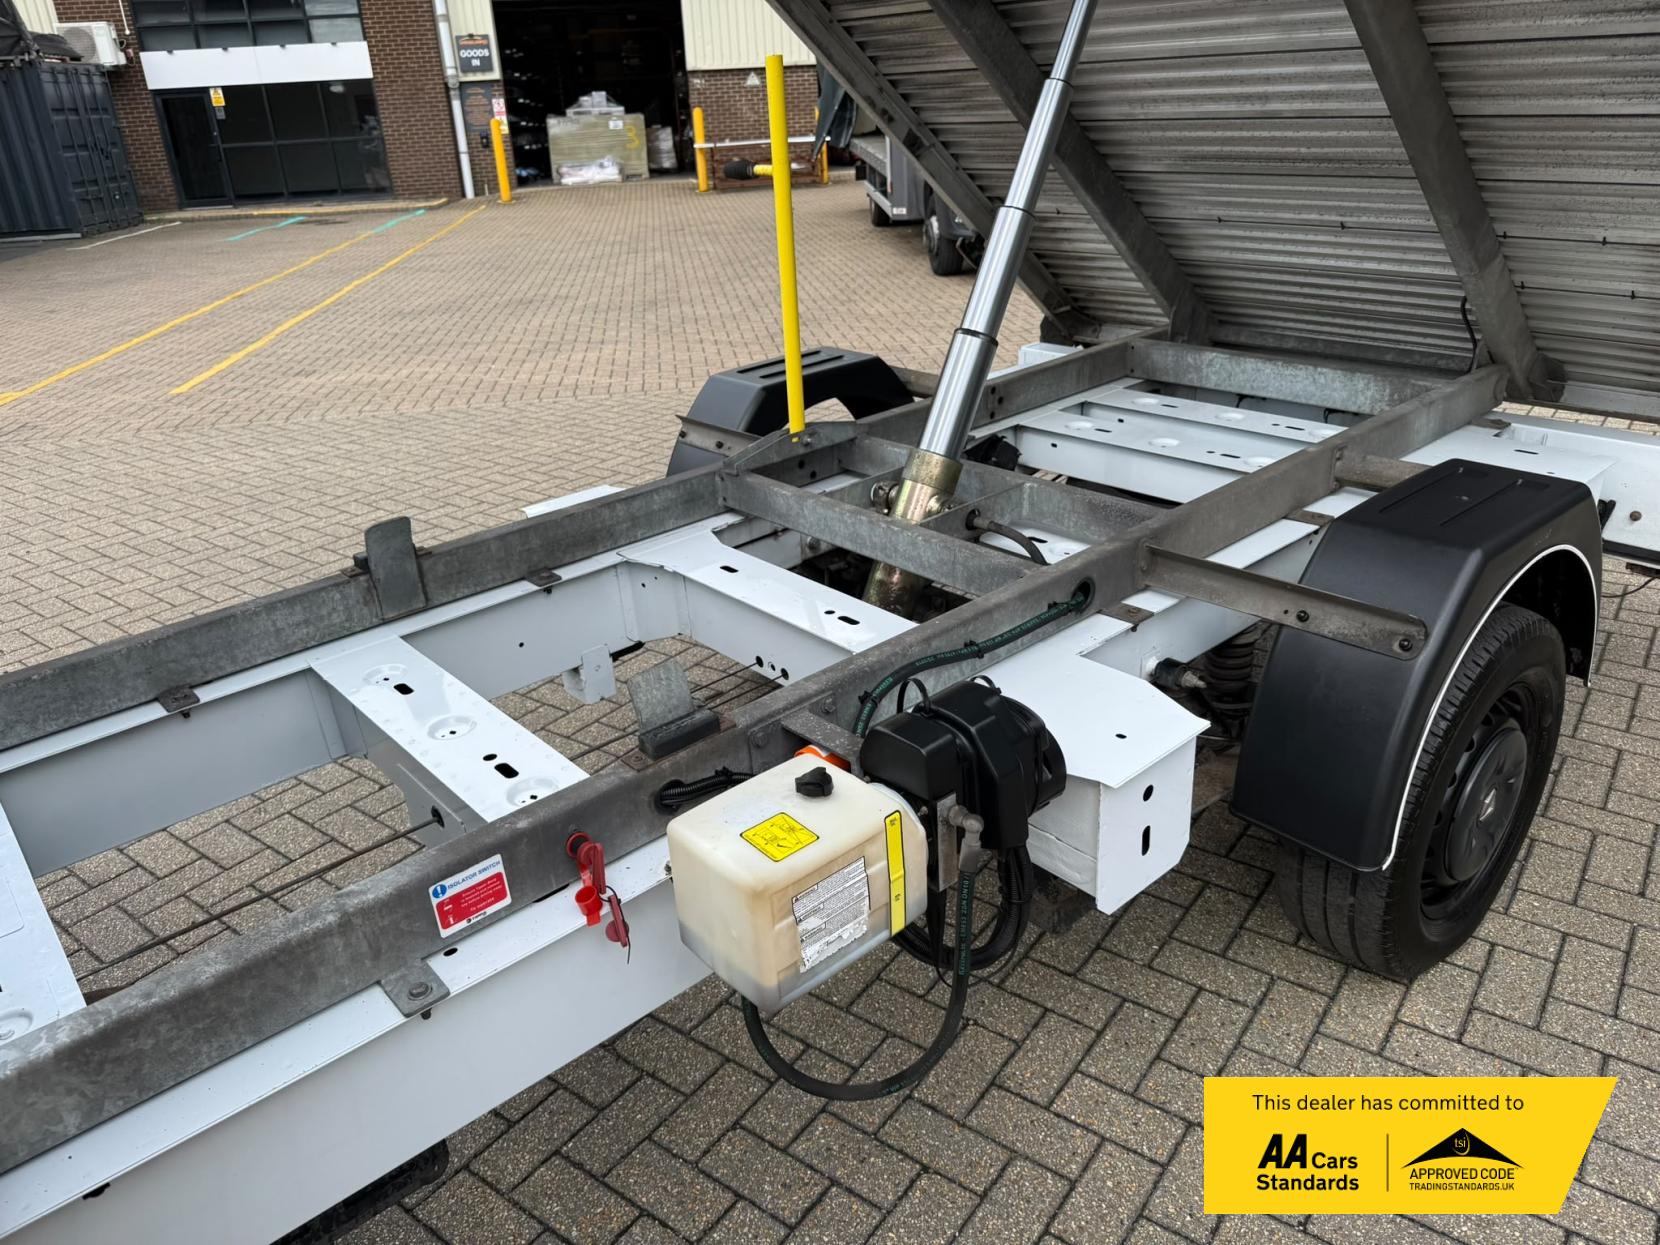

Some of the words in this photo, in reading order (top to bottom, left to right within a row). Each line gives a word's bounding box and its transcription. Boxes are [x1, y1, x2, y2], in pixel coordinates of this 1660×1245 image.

[460, 48, 489, 58] GOODS
[471, 58, 480, 67] IN
[448, 872, 477, 890] ISOLATOR
[478, 860, 501, 875] SWITCH
